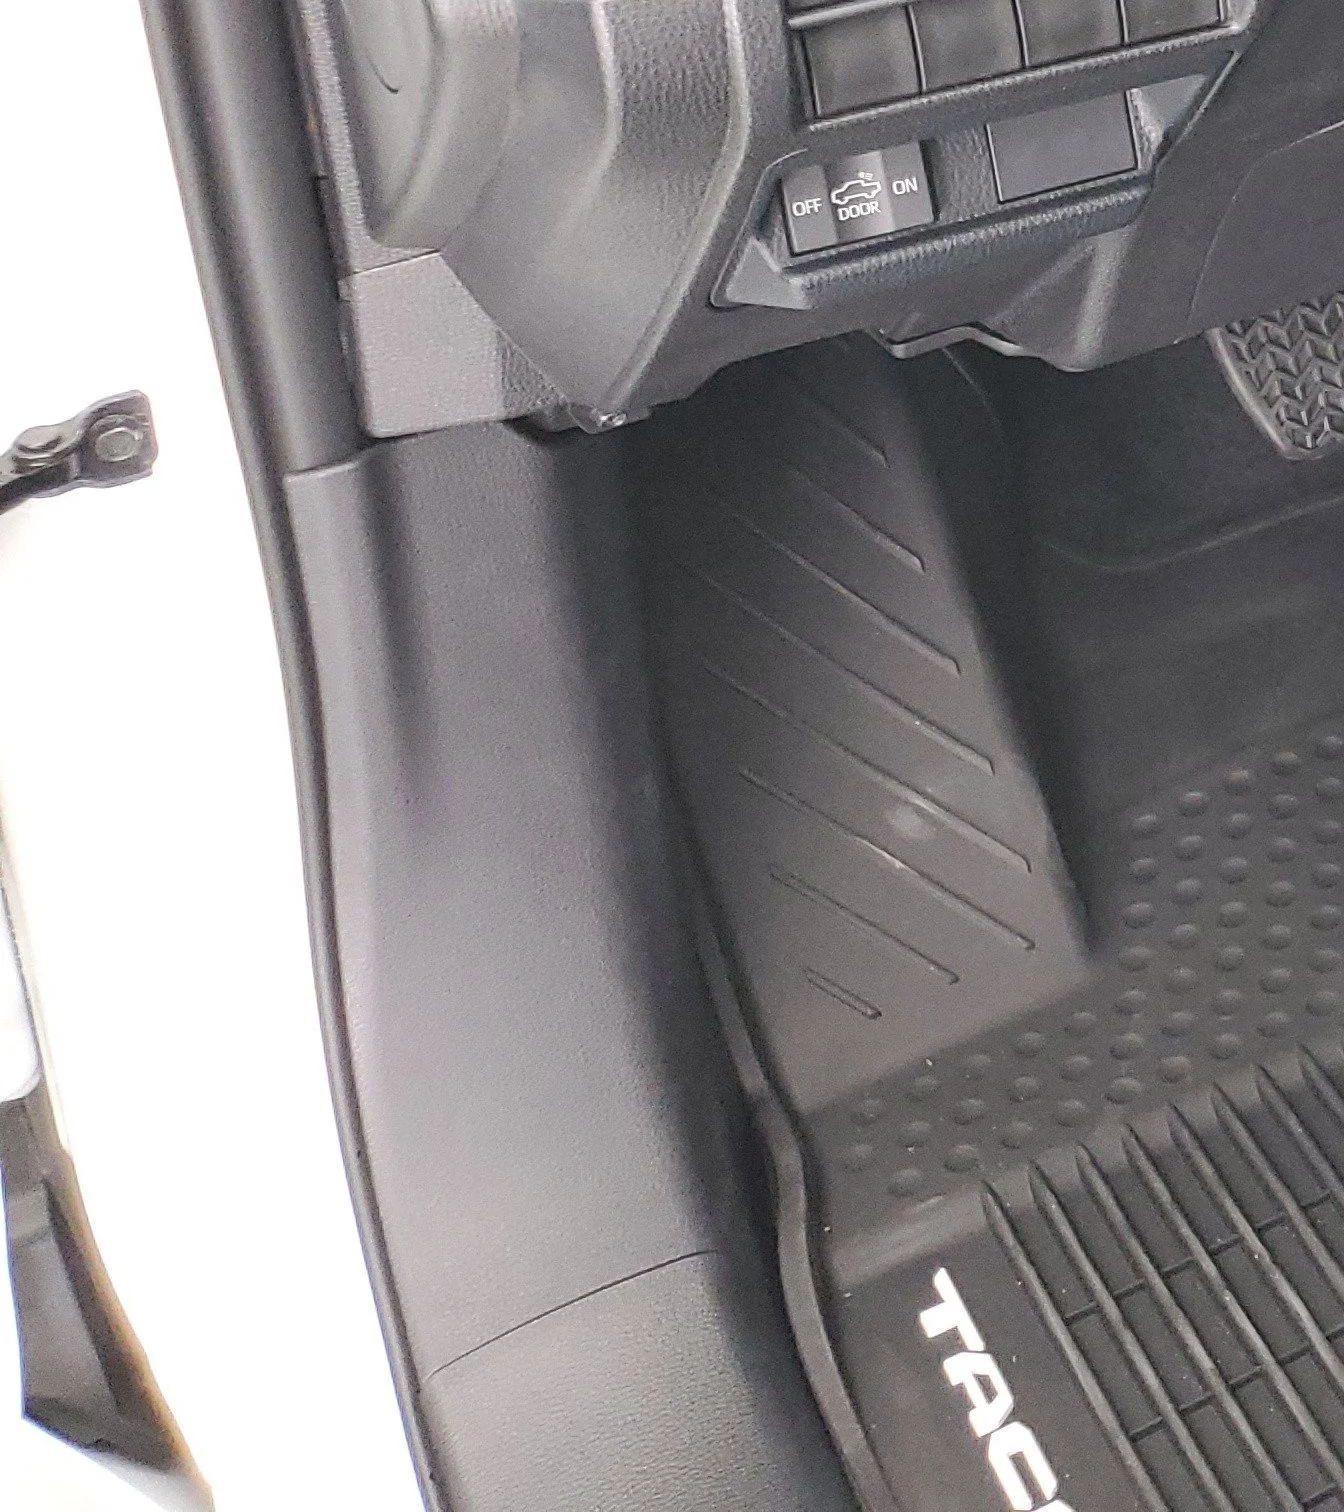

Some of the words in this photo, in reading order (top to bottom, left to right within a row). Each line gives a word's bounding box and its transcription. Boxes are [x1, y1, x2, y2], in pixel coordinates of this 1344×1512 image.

[792, 196, 823, 218] OFF
[892, 177, 918, 197] ON
[838, 200, 881, 221] DOOR
[920, 1267, 1075, 1512] TAC
